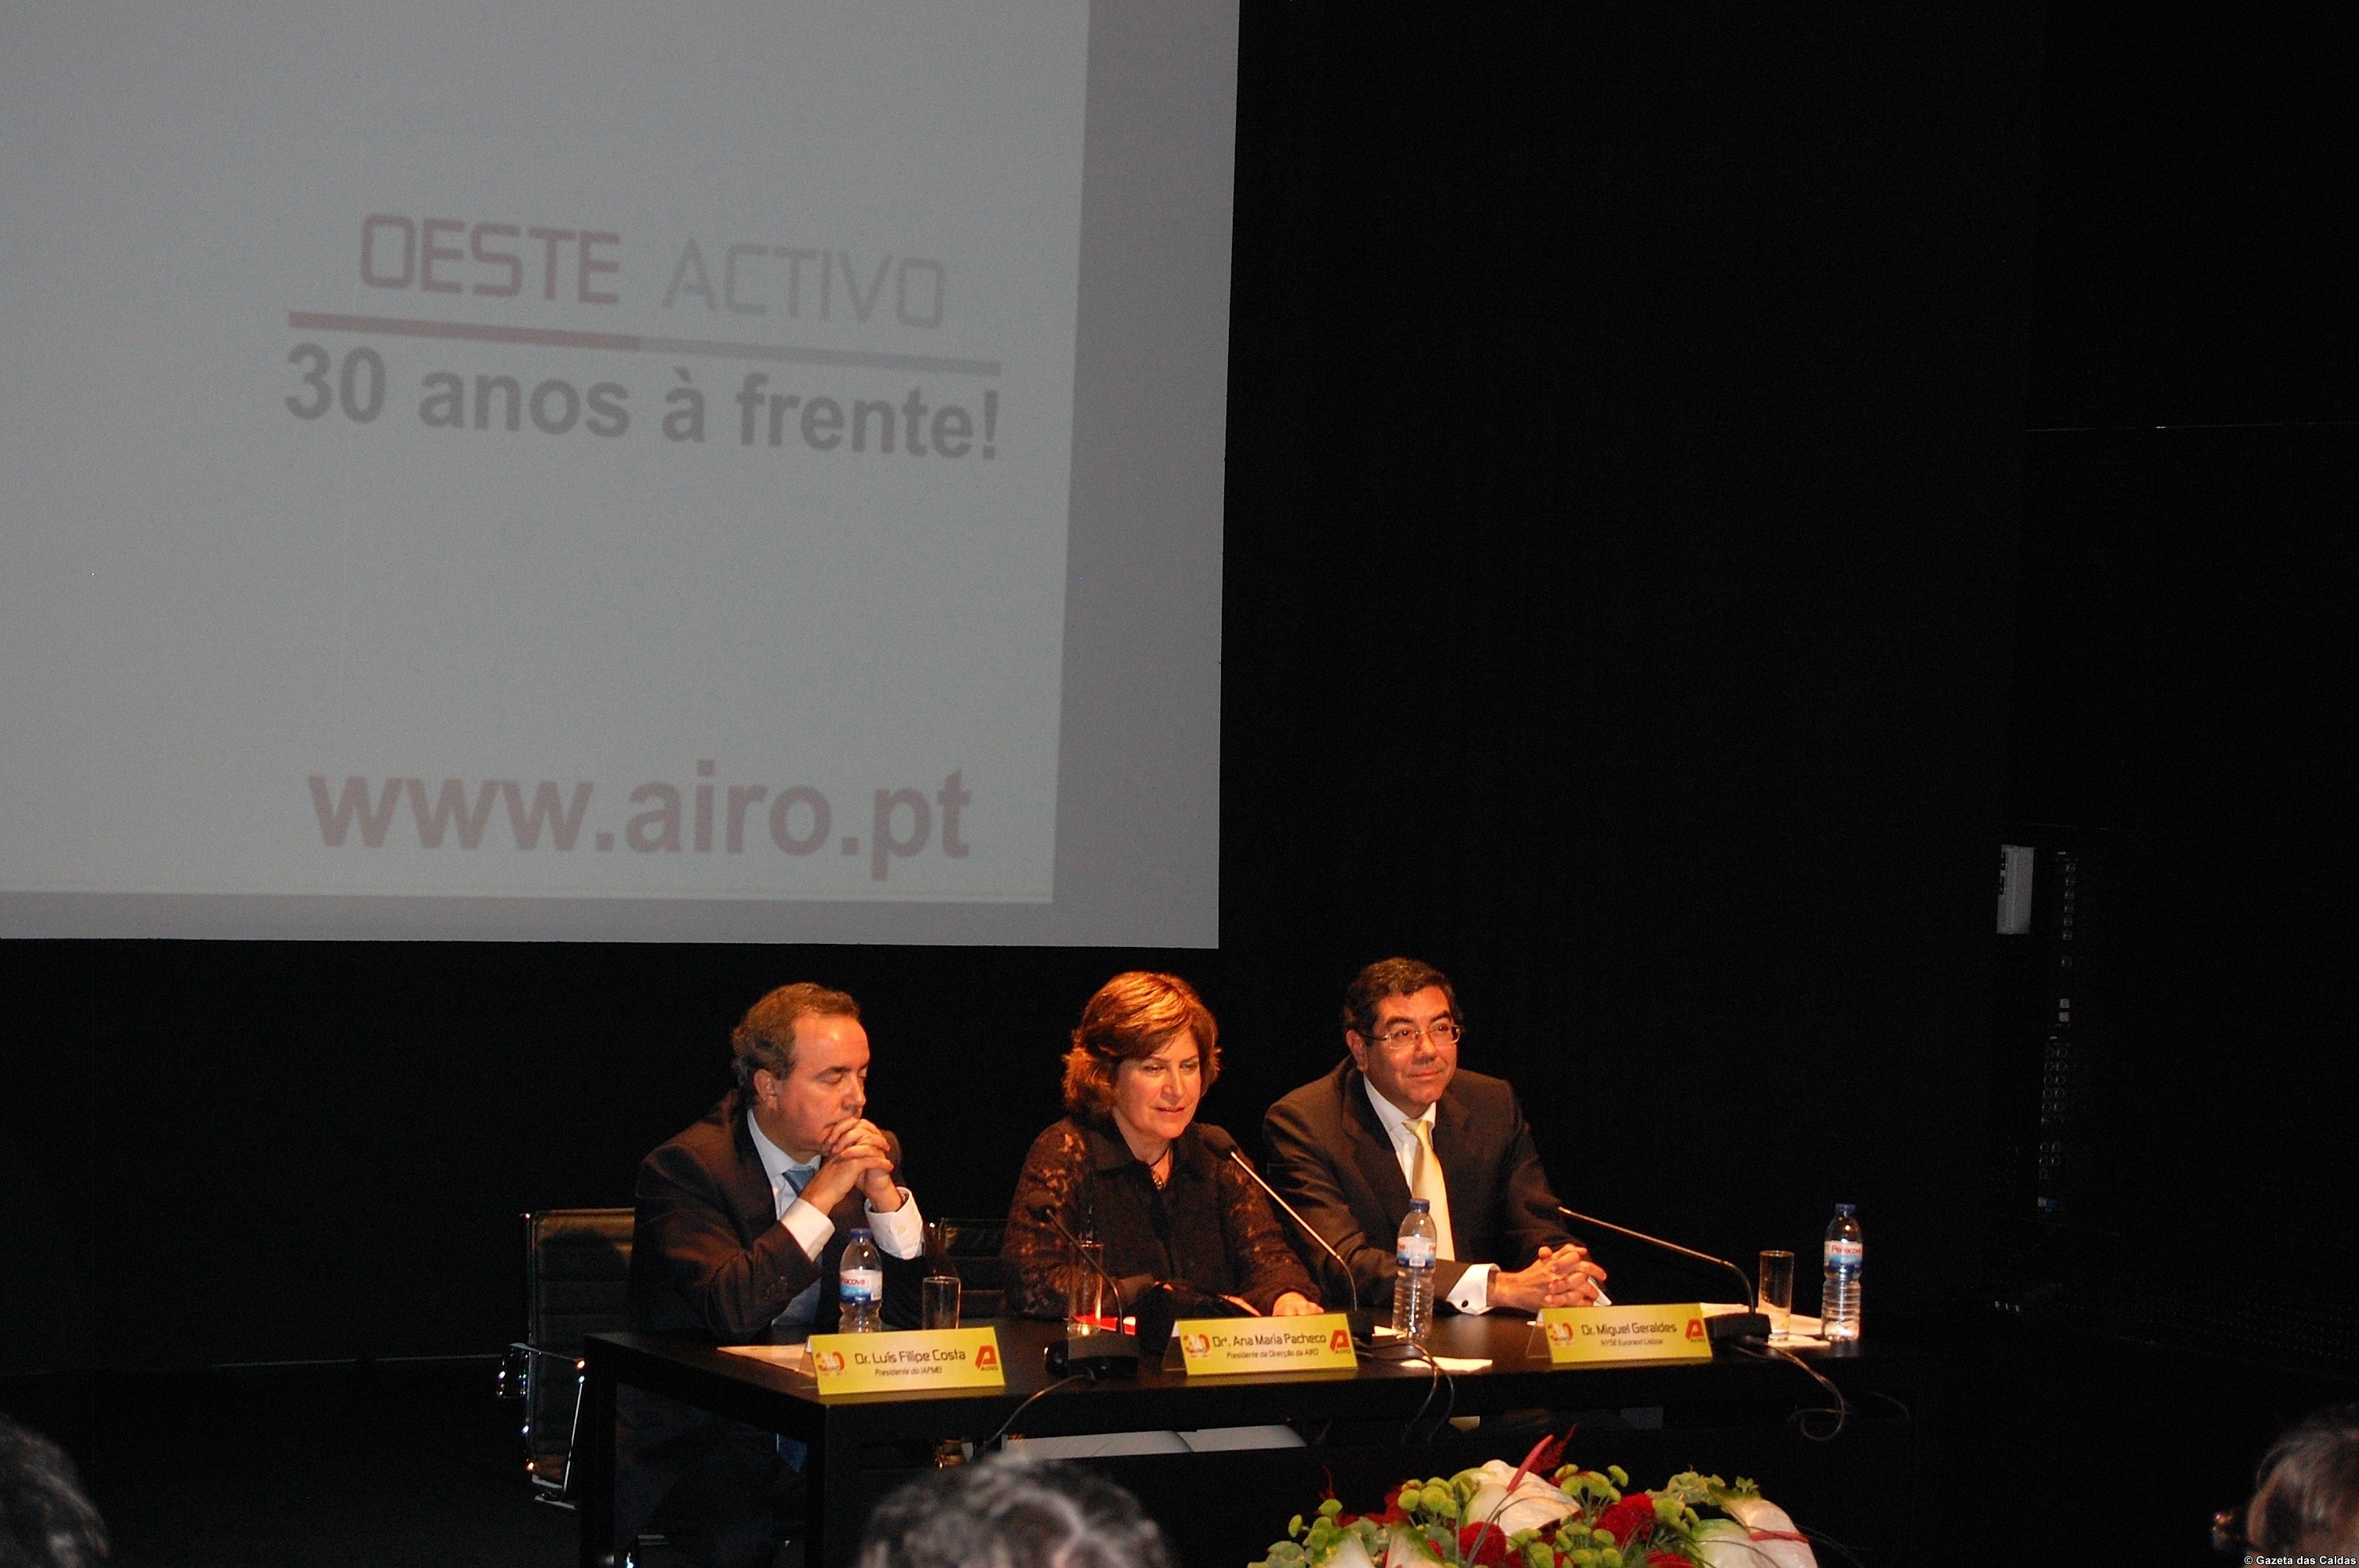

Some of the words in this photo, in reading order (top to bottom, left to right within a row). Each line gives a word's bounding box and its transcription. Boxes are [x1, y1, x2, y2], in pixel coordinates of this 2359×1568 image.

[359, 213, 620, 305] OESTE
[661, 237, 946, 328] ACTIVO
[284, 343, 387, 424] 30
[418, 369, 630, 438] anos
[660, 366, 706, 445] à
[735, 372, 1000, 461] frente!
[307, 758, 972, 881] www.airo.pt
[1581, 1324, 1595, 1335] Dr.
[1597, 1323, 1630, 1337] Miguel
[1631, 1322, 1677, 1334] Geraldes
[1233, 1335, 1254, 1346] Ana
[1255, 1334, 1282, 1345] Maria
[1285, 1333, 1326, 1344] Pacheco
[854, 1352, 871, 1364] Dr.
[873, 1351, 897, 1363] Luís
[900, 1349, 930, 1363] Filipe
[932, 1348, 966, 1361] Costa
[1227, 1351, 1259, 1359] Presidente
[875, 1367, 910, 1376] Presidente
